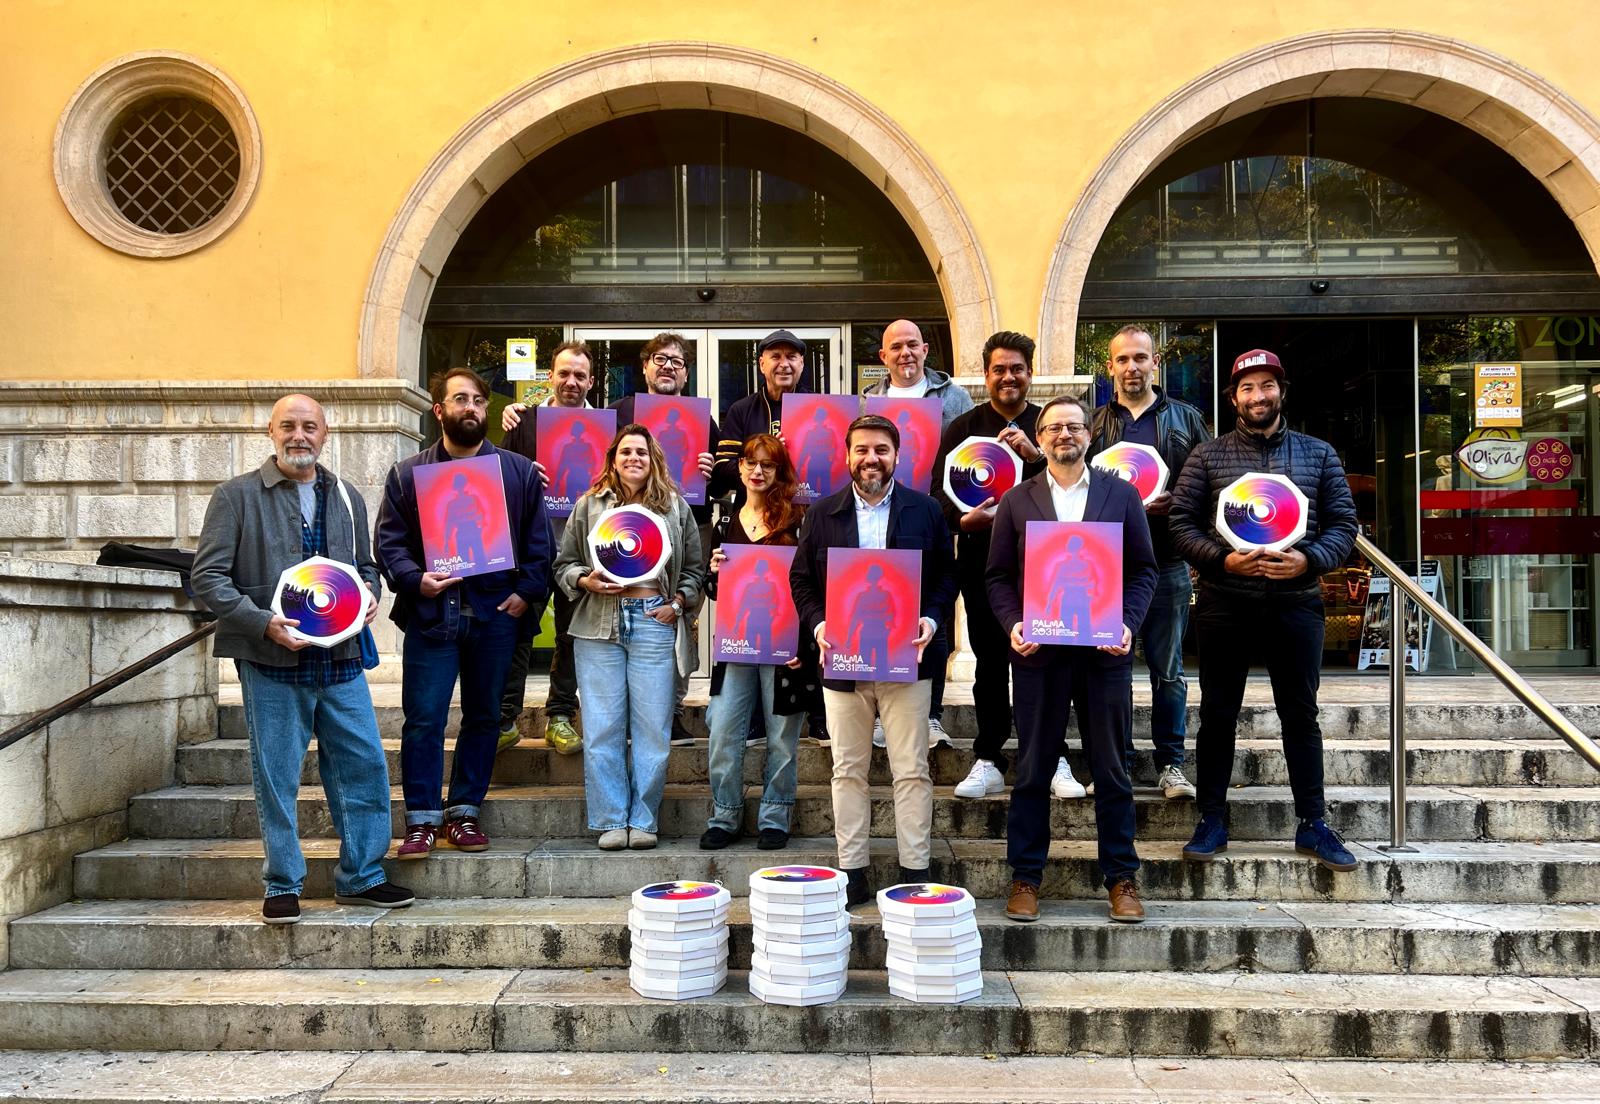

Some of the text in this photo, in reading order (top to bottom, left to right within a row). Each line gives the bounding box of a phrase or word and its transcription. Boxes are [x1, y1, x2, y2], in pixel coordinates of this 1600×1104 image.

[434, 555, 463, 567] PALMA
[1032, 619, 1065, 628] PALMA
[1031, 627, 1056, 636] 2031
[721, 638, 749, 647] PALMA
[721, 646, 742, 654] 2031
[832, 653, 864, 663] PALMA
[832, 662, 855, 671] 2031
